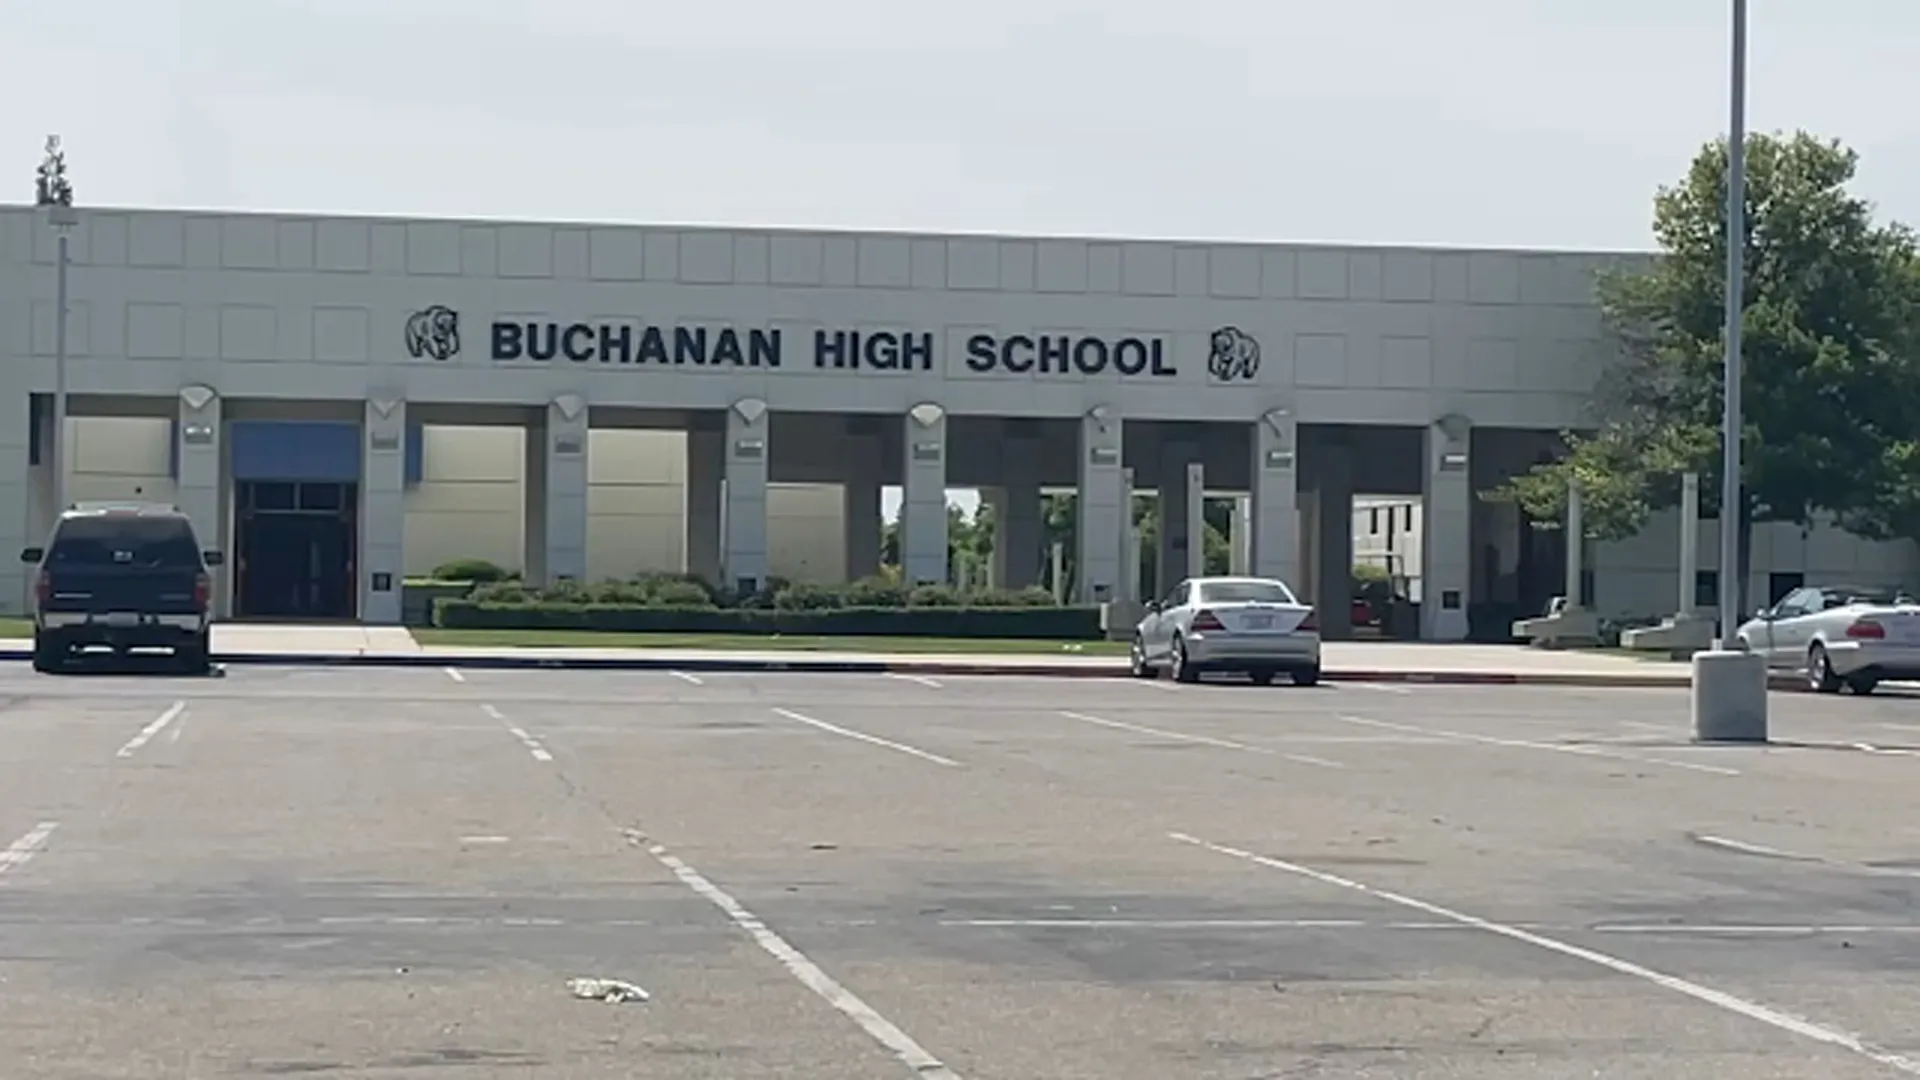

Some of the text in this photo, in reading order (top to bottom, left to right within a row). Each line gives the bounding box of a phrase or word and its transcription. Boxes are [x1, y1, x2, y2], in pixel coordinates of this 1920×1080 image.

[490, 321, 1178, 377] BUCHANAN HIGH SCHOOL
